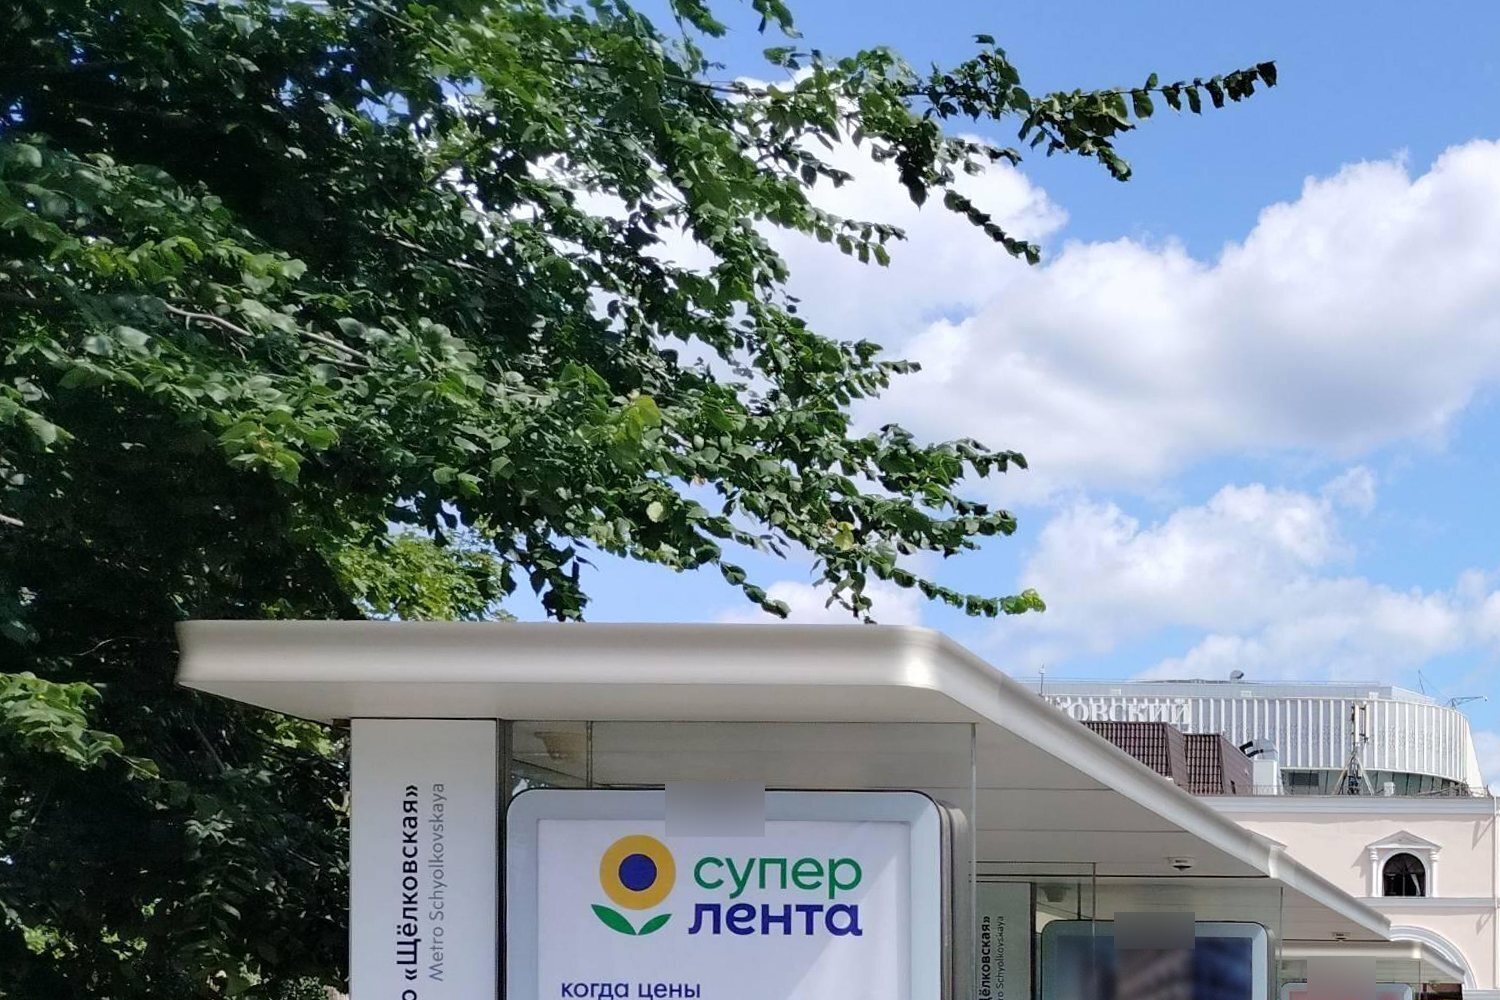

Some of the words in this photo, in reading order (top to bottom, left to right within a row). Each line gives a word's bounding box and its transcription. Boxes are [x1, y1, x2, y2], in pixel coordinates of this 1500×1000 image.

[427, 783, 447, 921] Schyolkovskaya
[693, 856, 863, 899] супер
[396, 785, 421, 980] «Щёлковская»
[688, 902, 863, 936] лента
[428, 926, 444, 982] Metro
